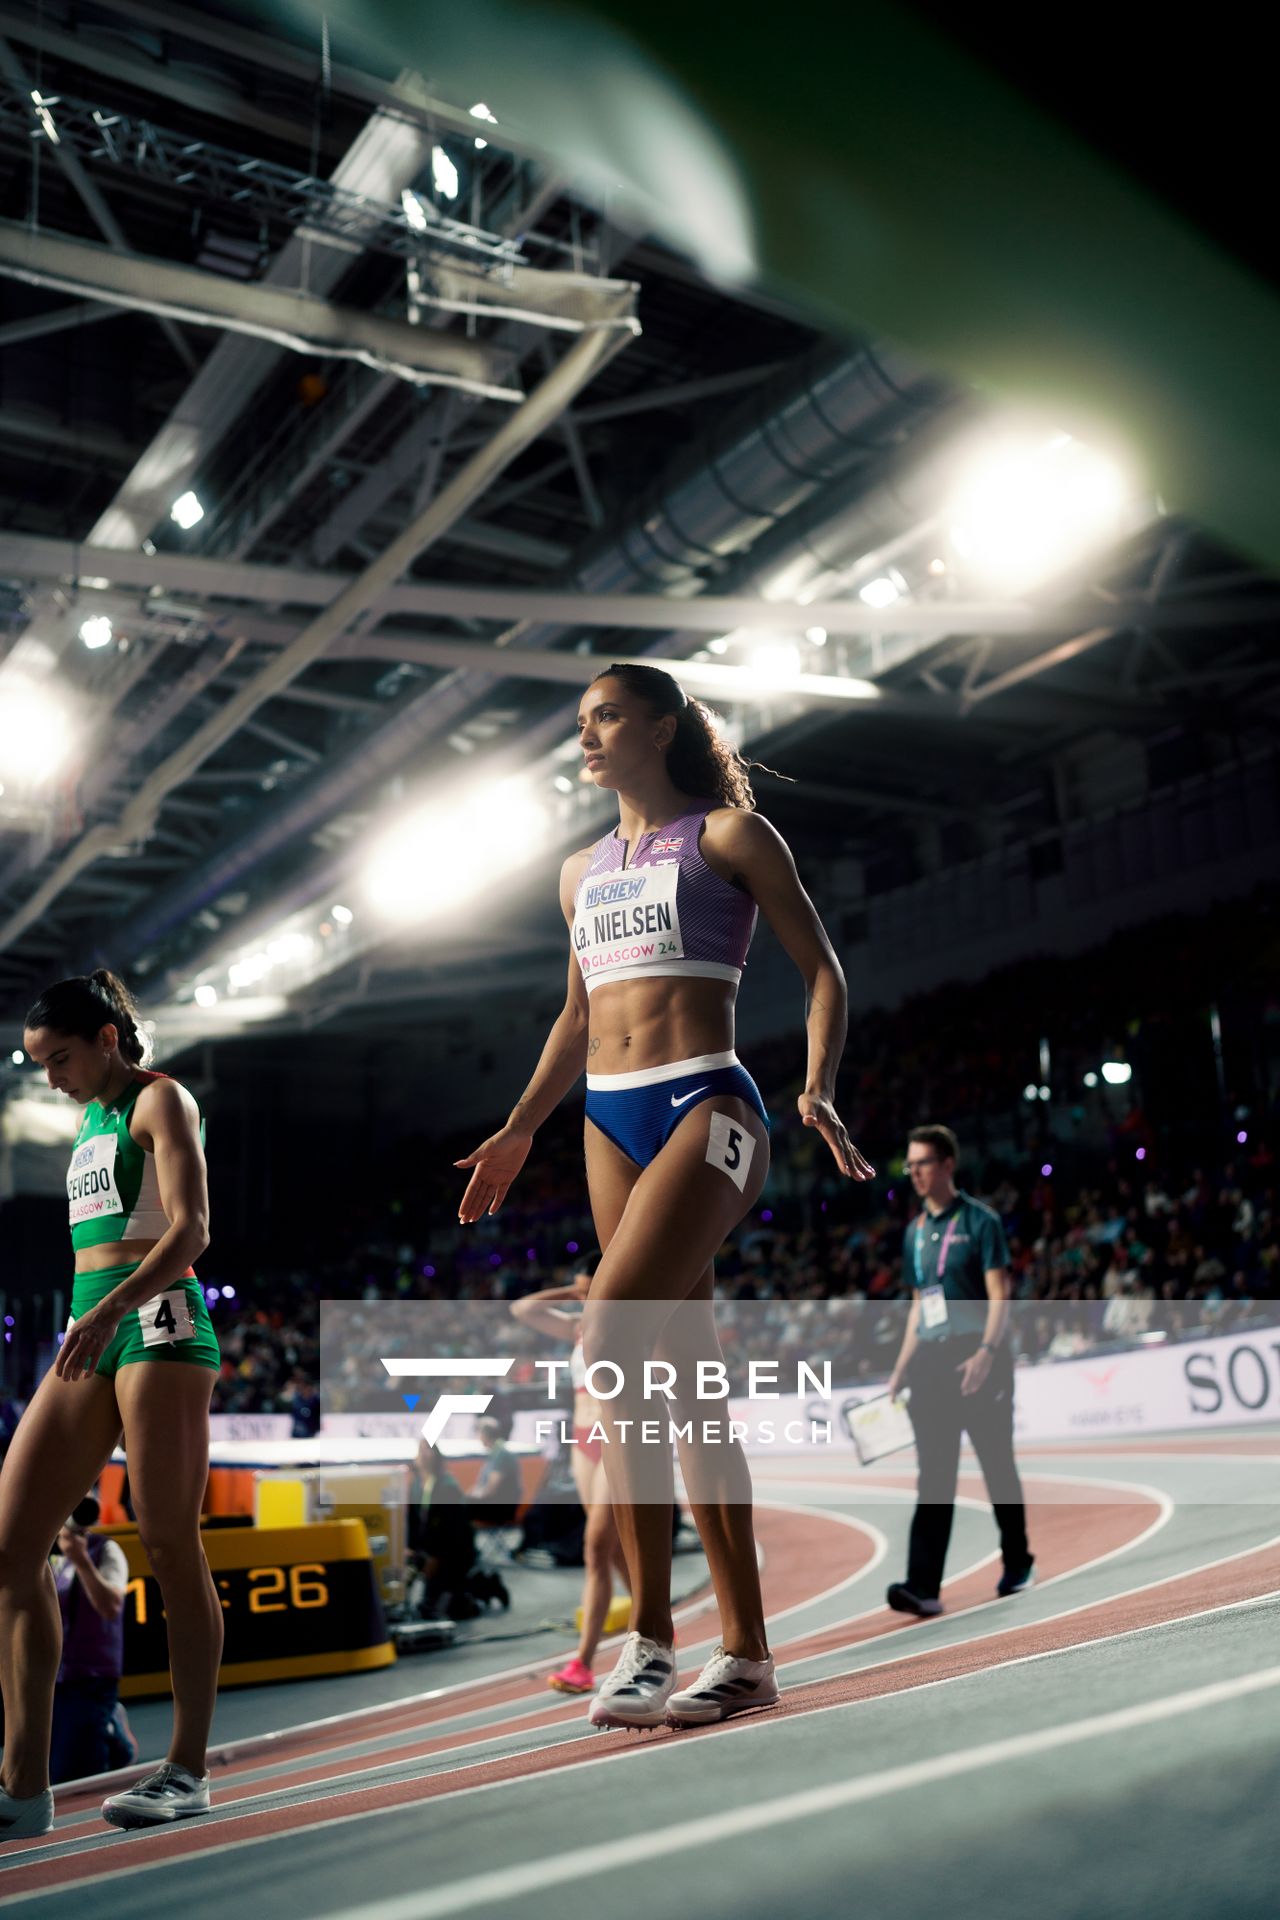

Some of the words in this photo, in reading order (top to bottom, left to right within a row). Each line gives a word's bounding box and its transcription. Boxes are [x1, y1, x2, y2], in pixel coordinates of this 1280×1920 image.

[586, 876, 646, 909] HI-CHEW
[594, 901, 672, 944] NIELSEN
[591, 943, 655, 968] GLASGOW
[658, 941, 677, 954] 24
[724, 1127, 743, 1170] 5
[106, 1199, 118, 1209] 24
[153, 1299, 177, 1334] 4
[1184, 1343, 1280, 1413] SO
